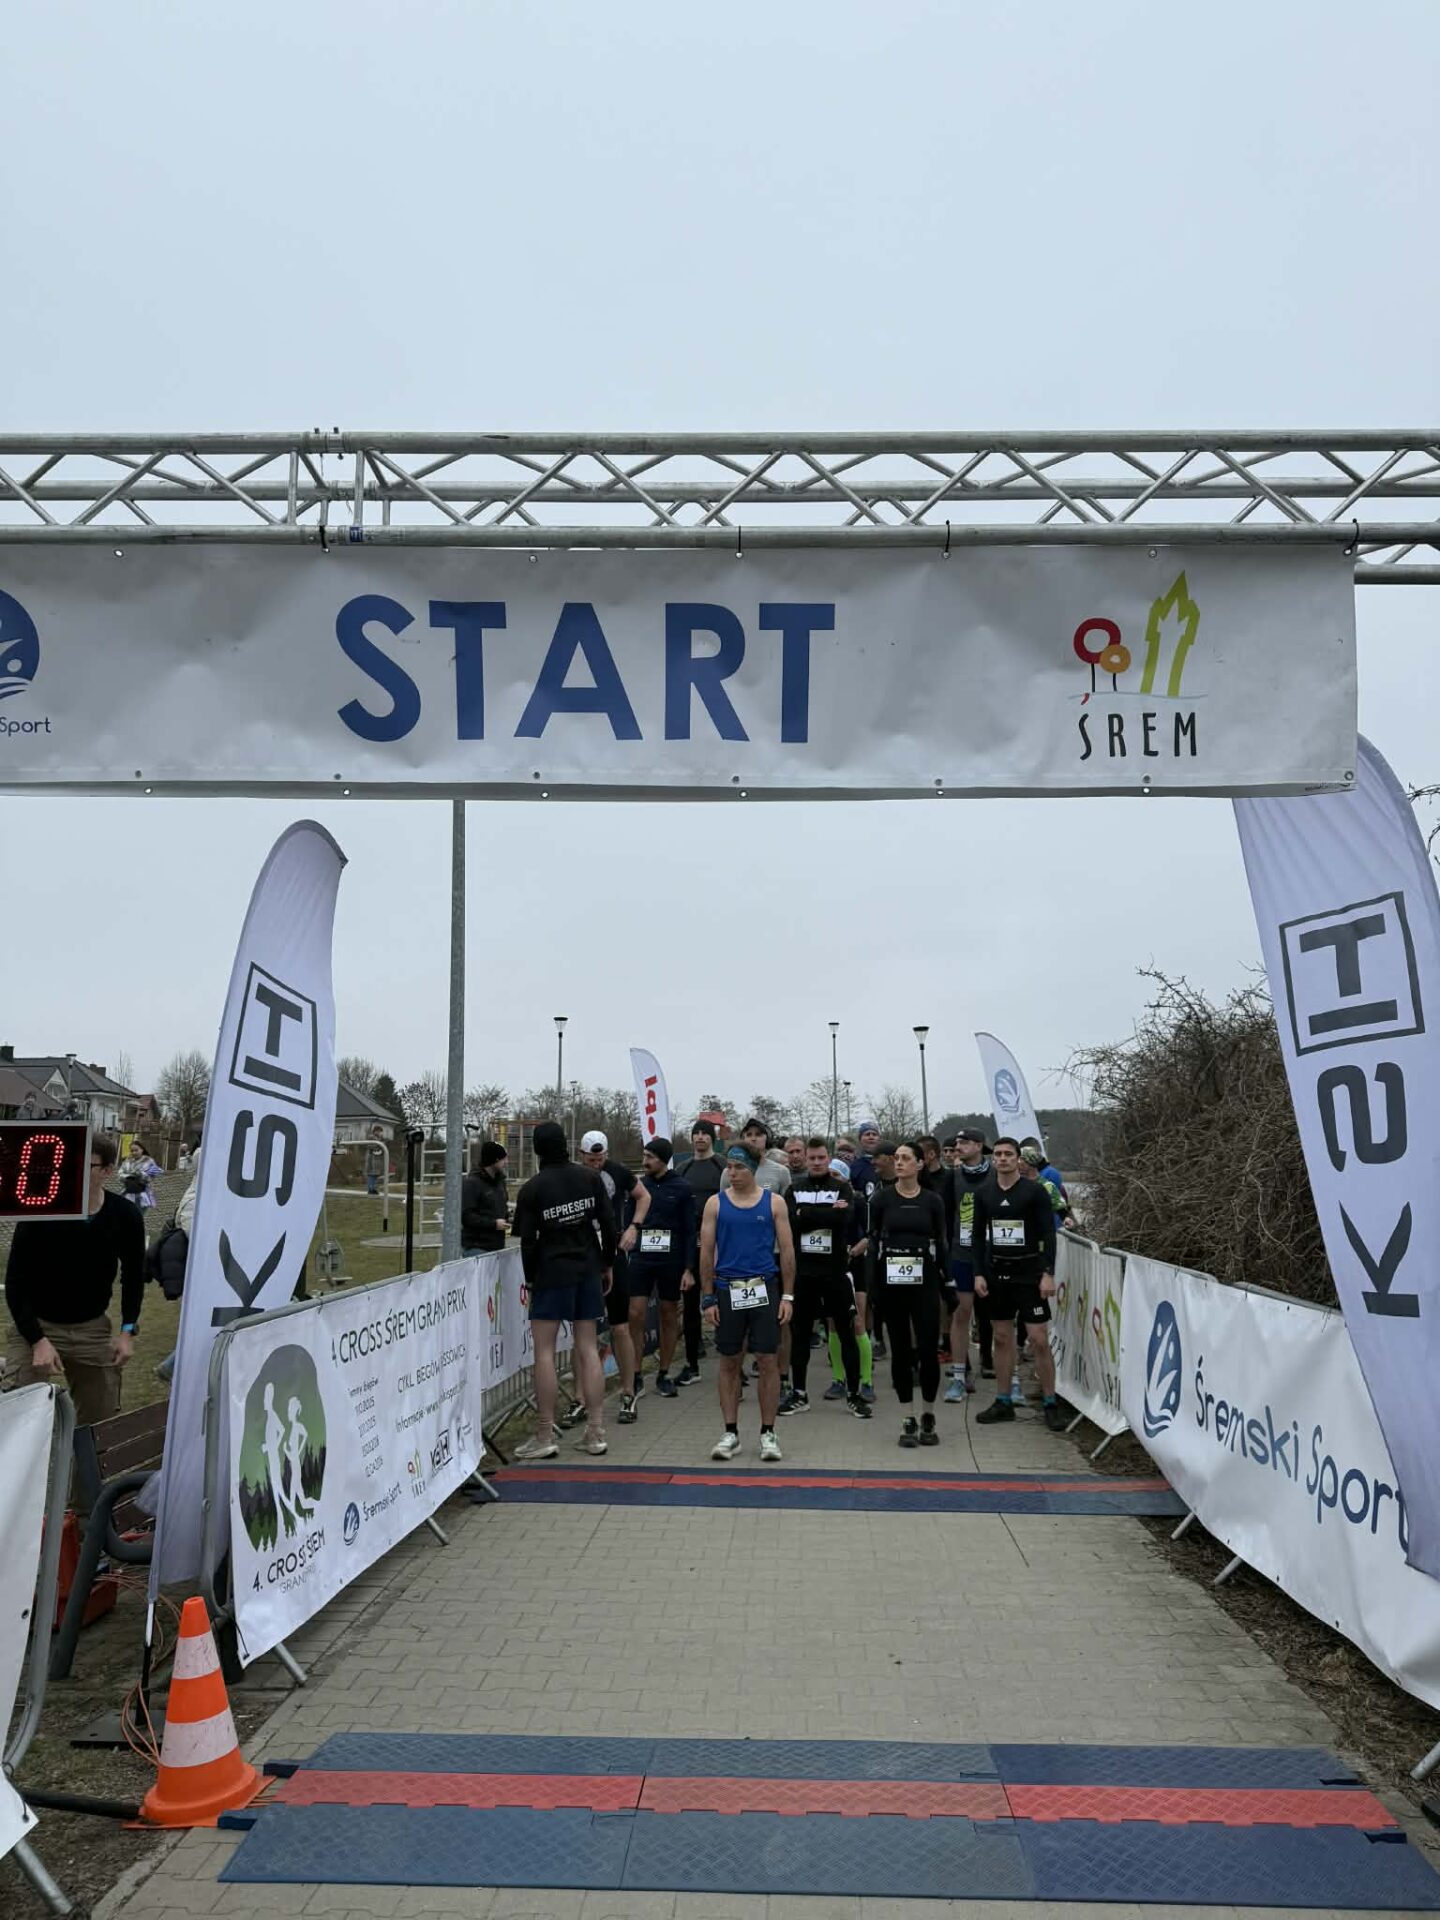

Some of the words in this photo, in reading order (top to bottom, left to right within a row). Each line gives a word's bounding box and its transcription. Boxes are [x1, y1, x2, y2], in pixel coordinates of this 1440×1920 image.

[335, 593, 836, 744] START
[0, 716, 52, 737] Sport
[1079, 693, 1197, 761] ŚREM
[543, 1197, 596, 1221] REPRESENT
[649, 1236, 662, 1245] 47
[809, 1235, 823, 1246] 84
[1001, 1228, 1015, 1238] 17
[898, 1265, 914, 1276] 49
[741, 1287, 757, 1300] 34
[339, 1320, 383, 1364] CROSS
[385, 1308, 416, 1345] ŚREM
[446, 1286, 467, 1318] PRIX
[1196, 1354, 1300, 1482] Śremski
[1306, 1425, 1410, 1553] Sport
[252, 1571, 263, 1592] 4.
